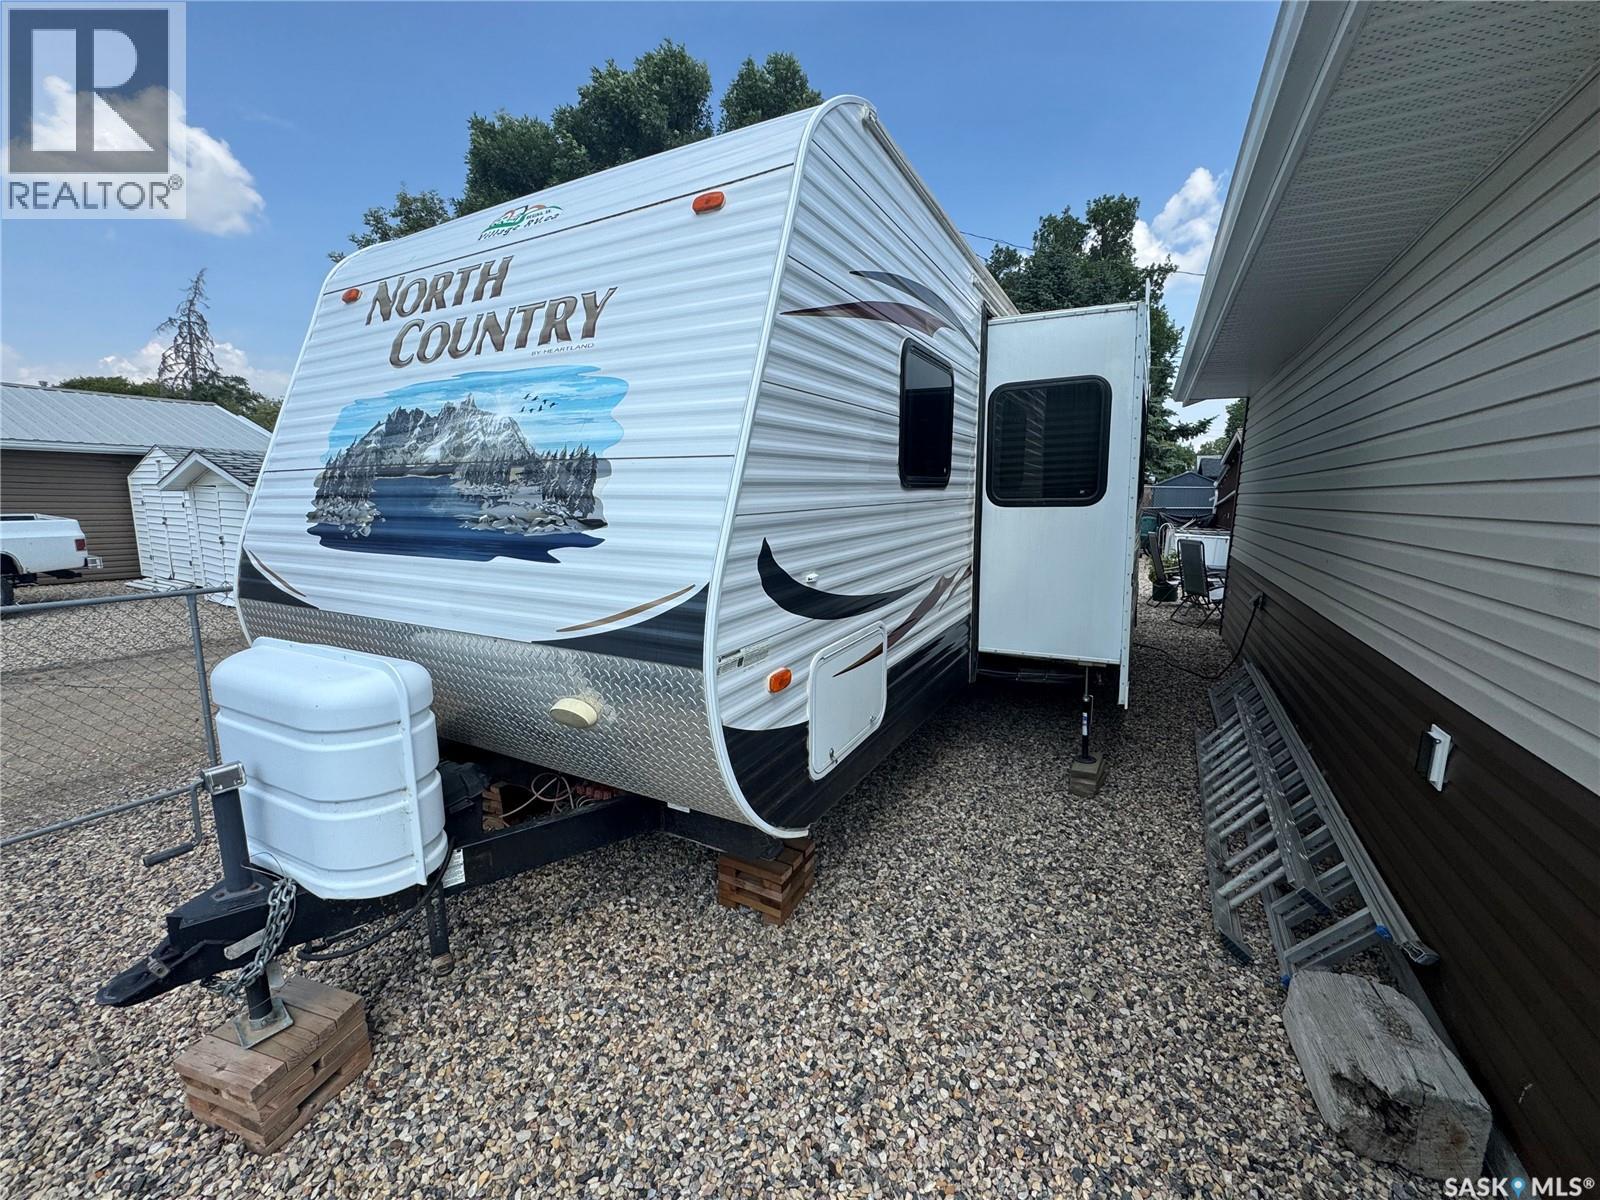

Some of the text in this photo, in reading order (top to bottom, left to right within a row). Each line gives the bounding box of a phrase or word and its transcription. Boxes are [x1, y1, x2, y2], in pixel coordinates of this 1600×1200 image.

[478, 224, 520, 241] Village
[365, 255, 514, 326] NORTH
[389, 287, 618, 368] COUNTRY
[543, 342, 595, 355] HEARTLAND
